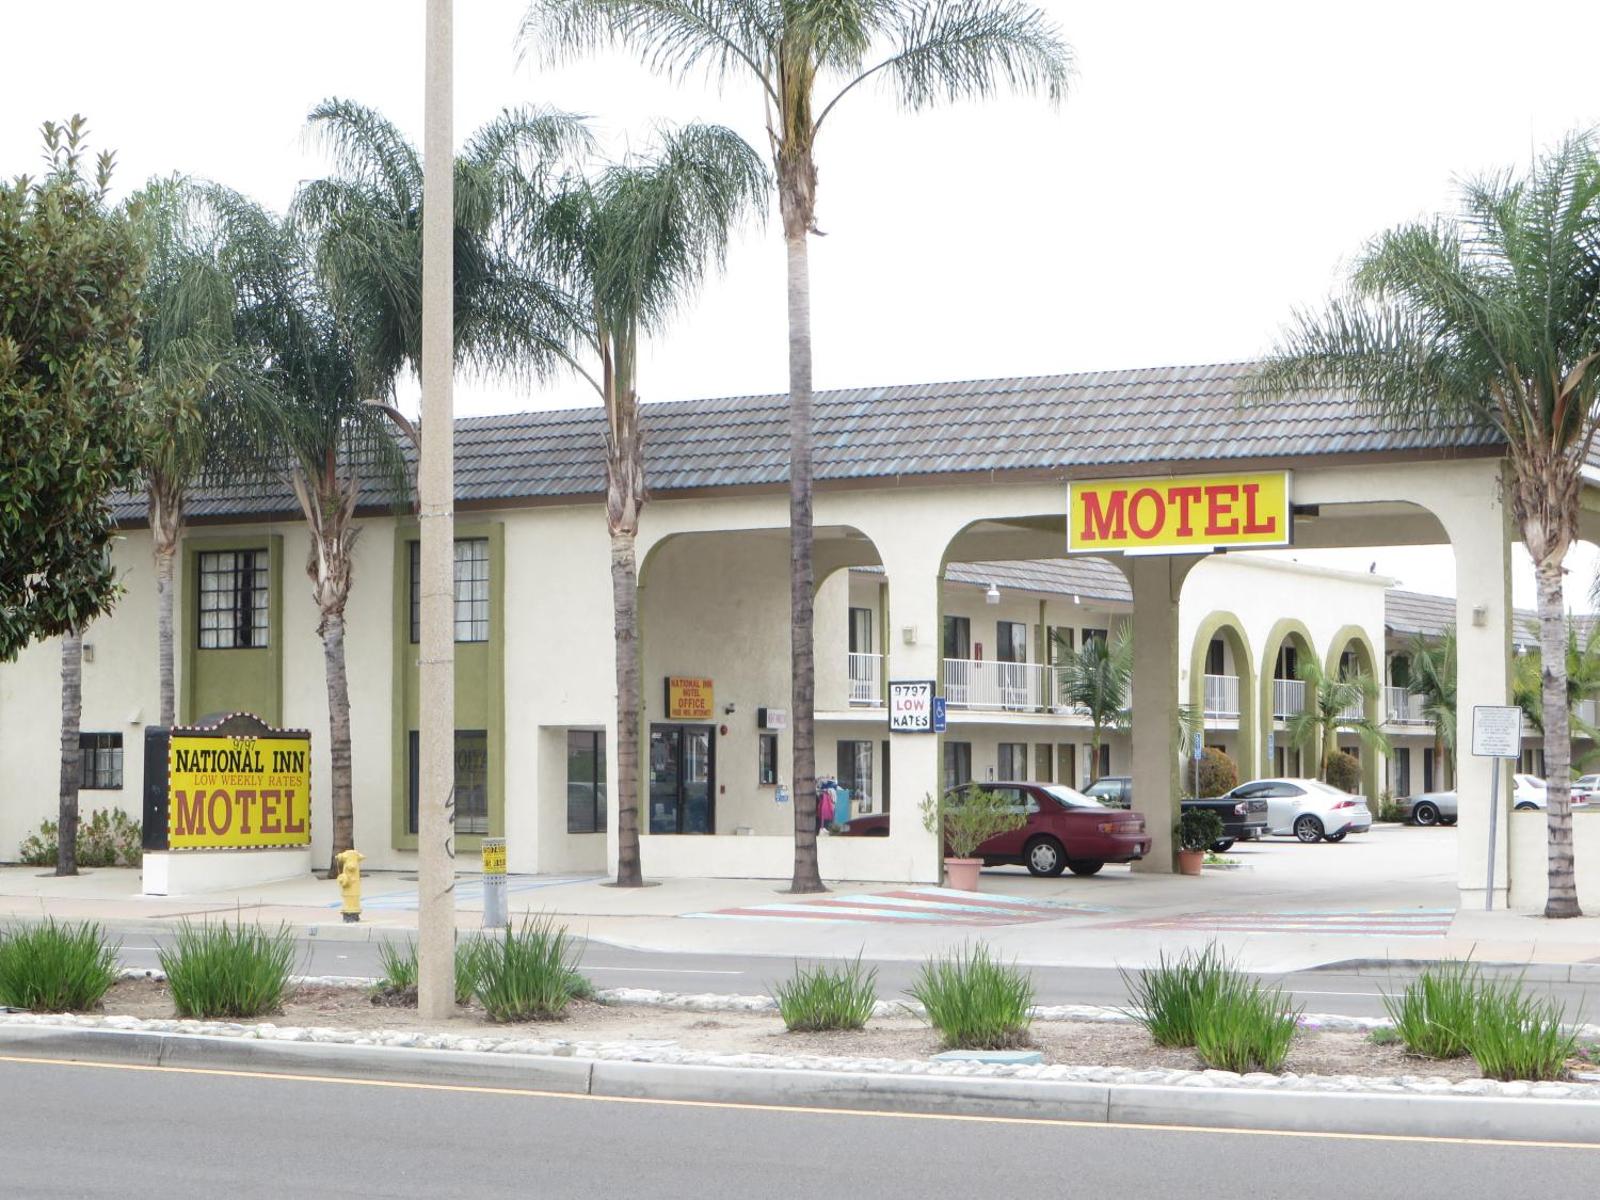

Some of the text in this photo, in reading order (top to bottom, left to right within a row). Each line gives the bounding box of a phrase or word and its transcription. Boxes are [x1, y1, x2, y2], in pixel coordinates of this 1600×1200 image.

[1080, 484, 1276, 541] MOTEL
[894, 686, 928, 697] 9797
[678, 698, 705, 709] OFFICE
[896, 699, 924, 711] LOW
[233, 739, 256, 751] 9797
[175, 749, 305, 773] NATIONAL INN
[194, 775, 303, 787] LOW WEEKLY RATES
[175, 789, 305, 836] MOTEL
